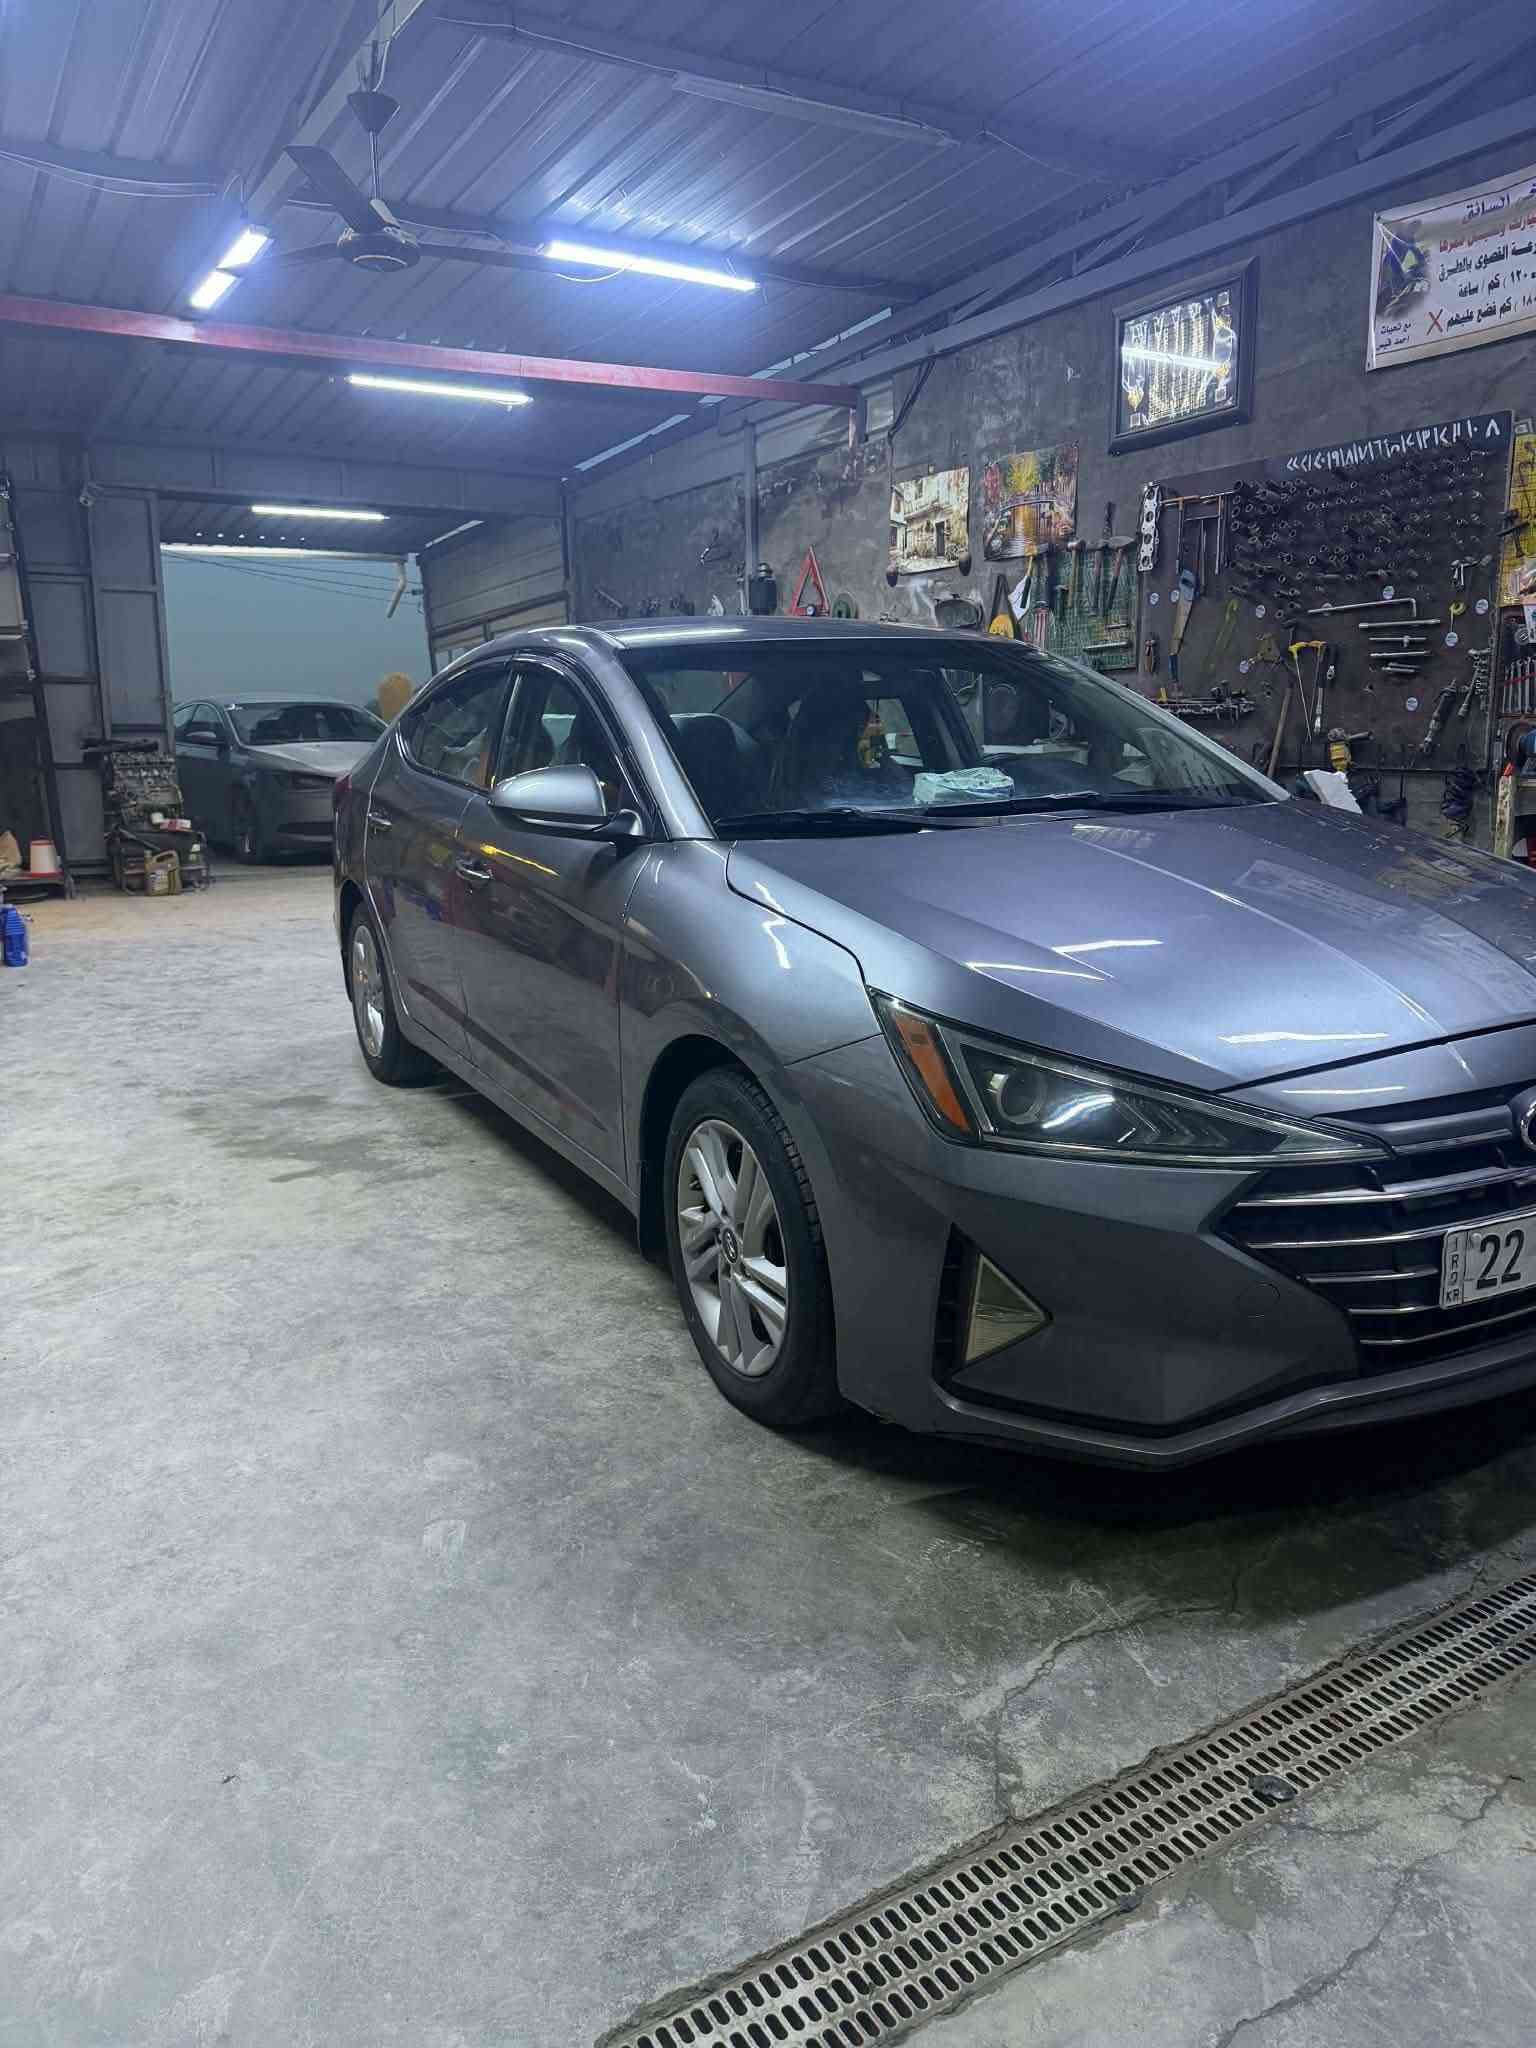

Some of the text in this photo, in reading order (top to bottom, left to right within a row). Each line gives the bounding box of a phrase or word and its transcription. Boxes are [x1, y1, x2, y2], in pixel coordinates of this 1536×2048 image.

[1474, 243, 1509, 270] القصوى
[1439, 256, 1472, 282] بالطرق
[1458, 280, 1479, 298] ساعة
[1487, 273, 1500, 296] كم
[1499, 296, 1512, 320] كم
[1486, 418, 1500, 438] ٨
[1476, 1229, 1525, 1290] 22
